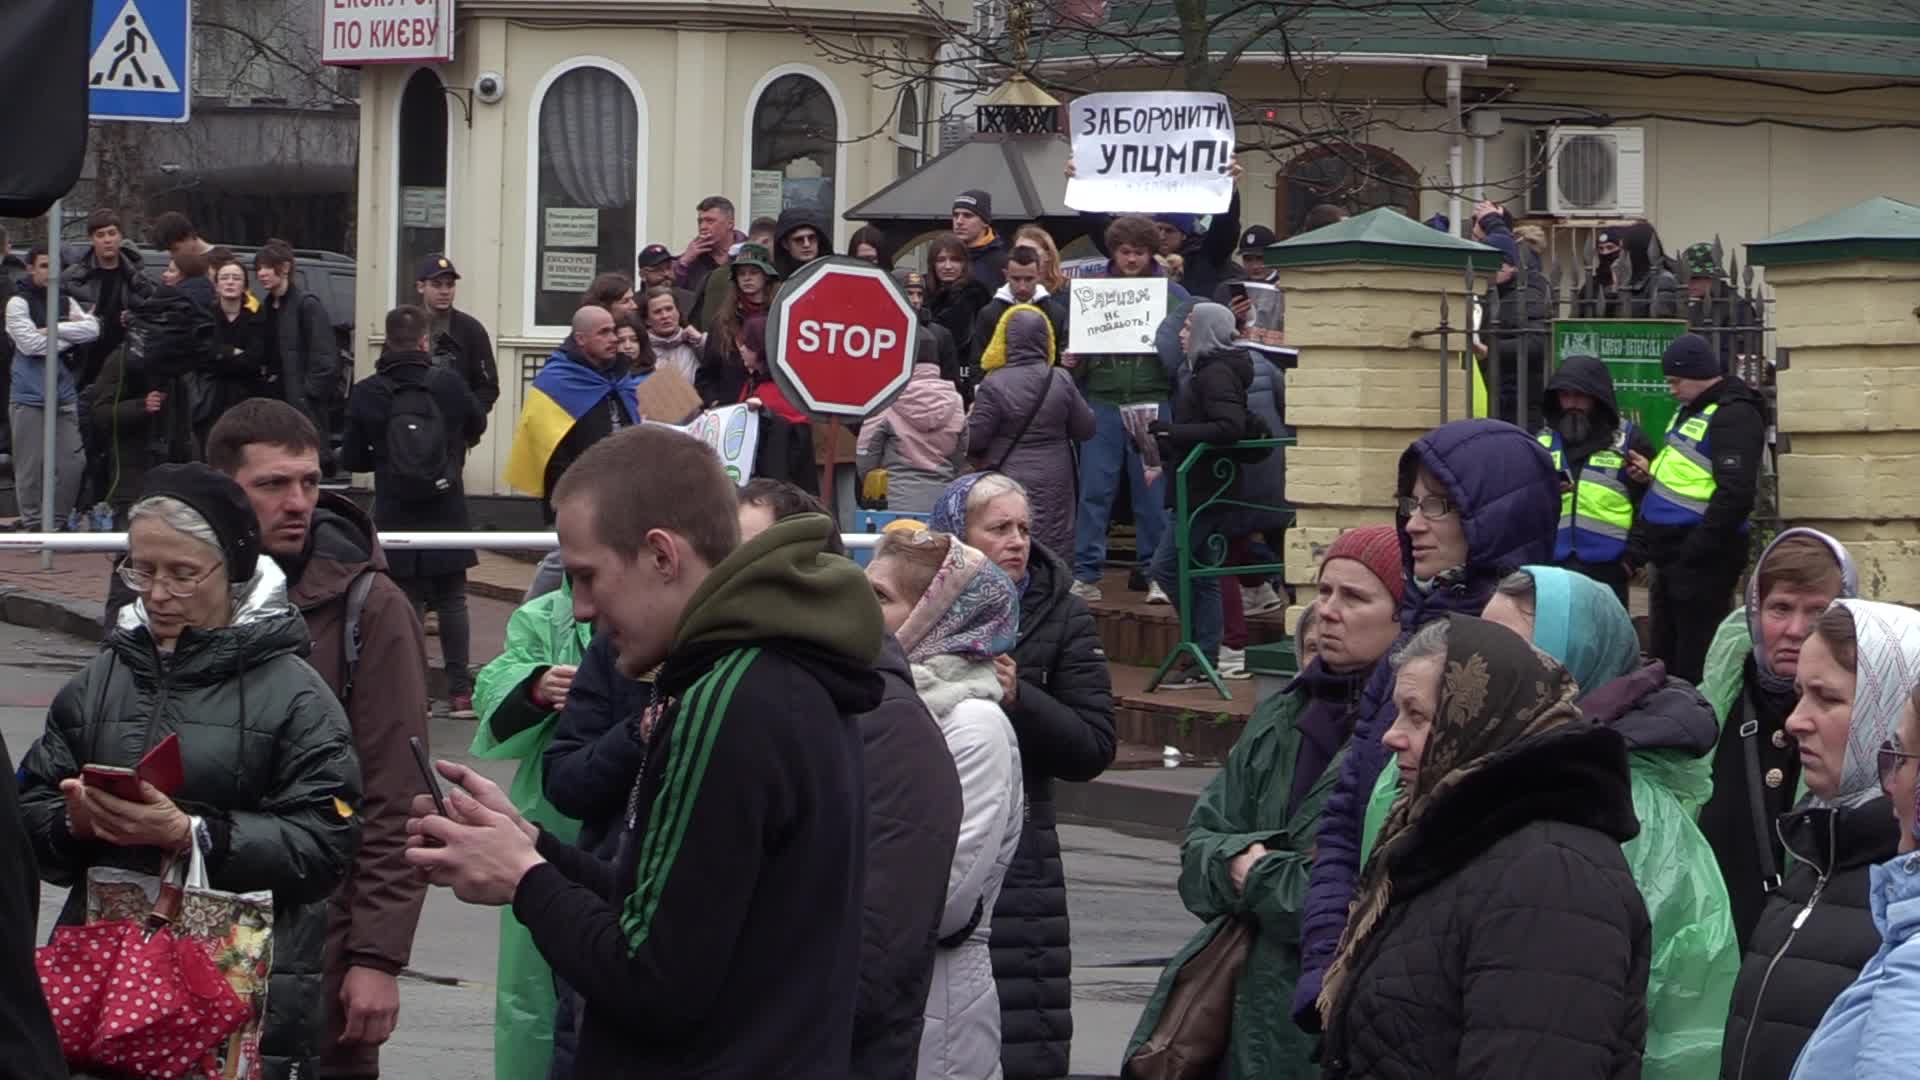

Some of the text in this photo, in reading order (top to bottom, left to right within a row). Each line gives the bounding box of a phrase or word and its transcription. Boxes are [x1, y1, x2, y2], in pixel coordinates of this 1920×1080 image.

[334, 16, 440, 48] ПО КИЄВУ
[1082, 102, 1231, 136] ЗАБОРОНИТИ
[797, 319, 897, 359] STOP
